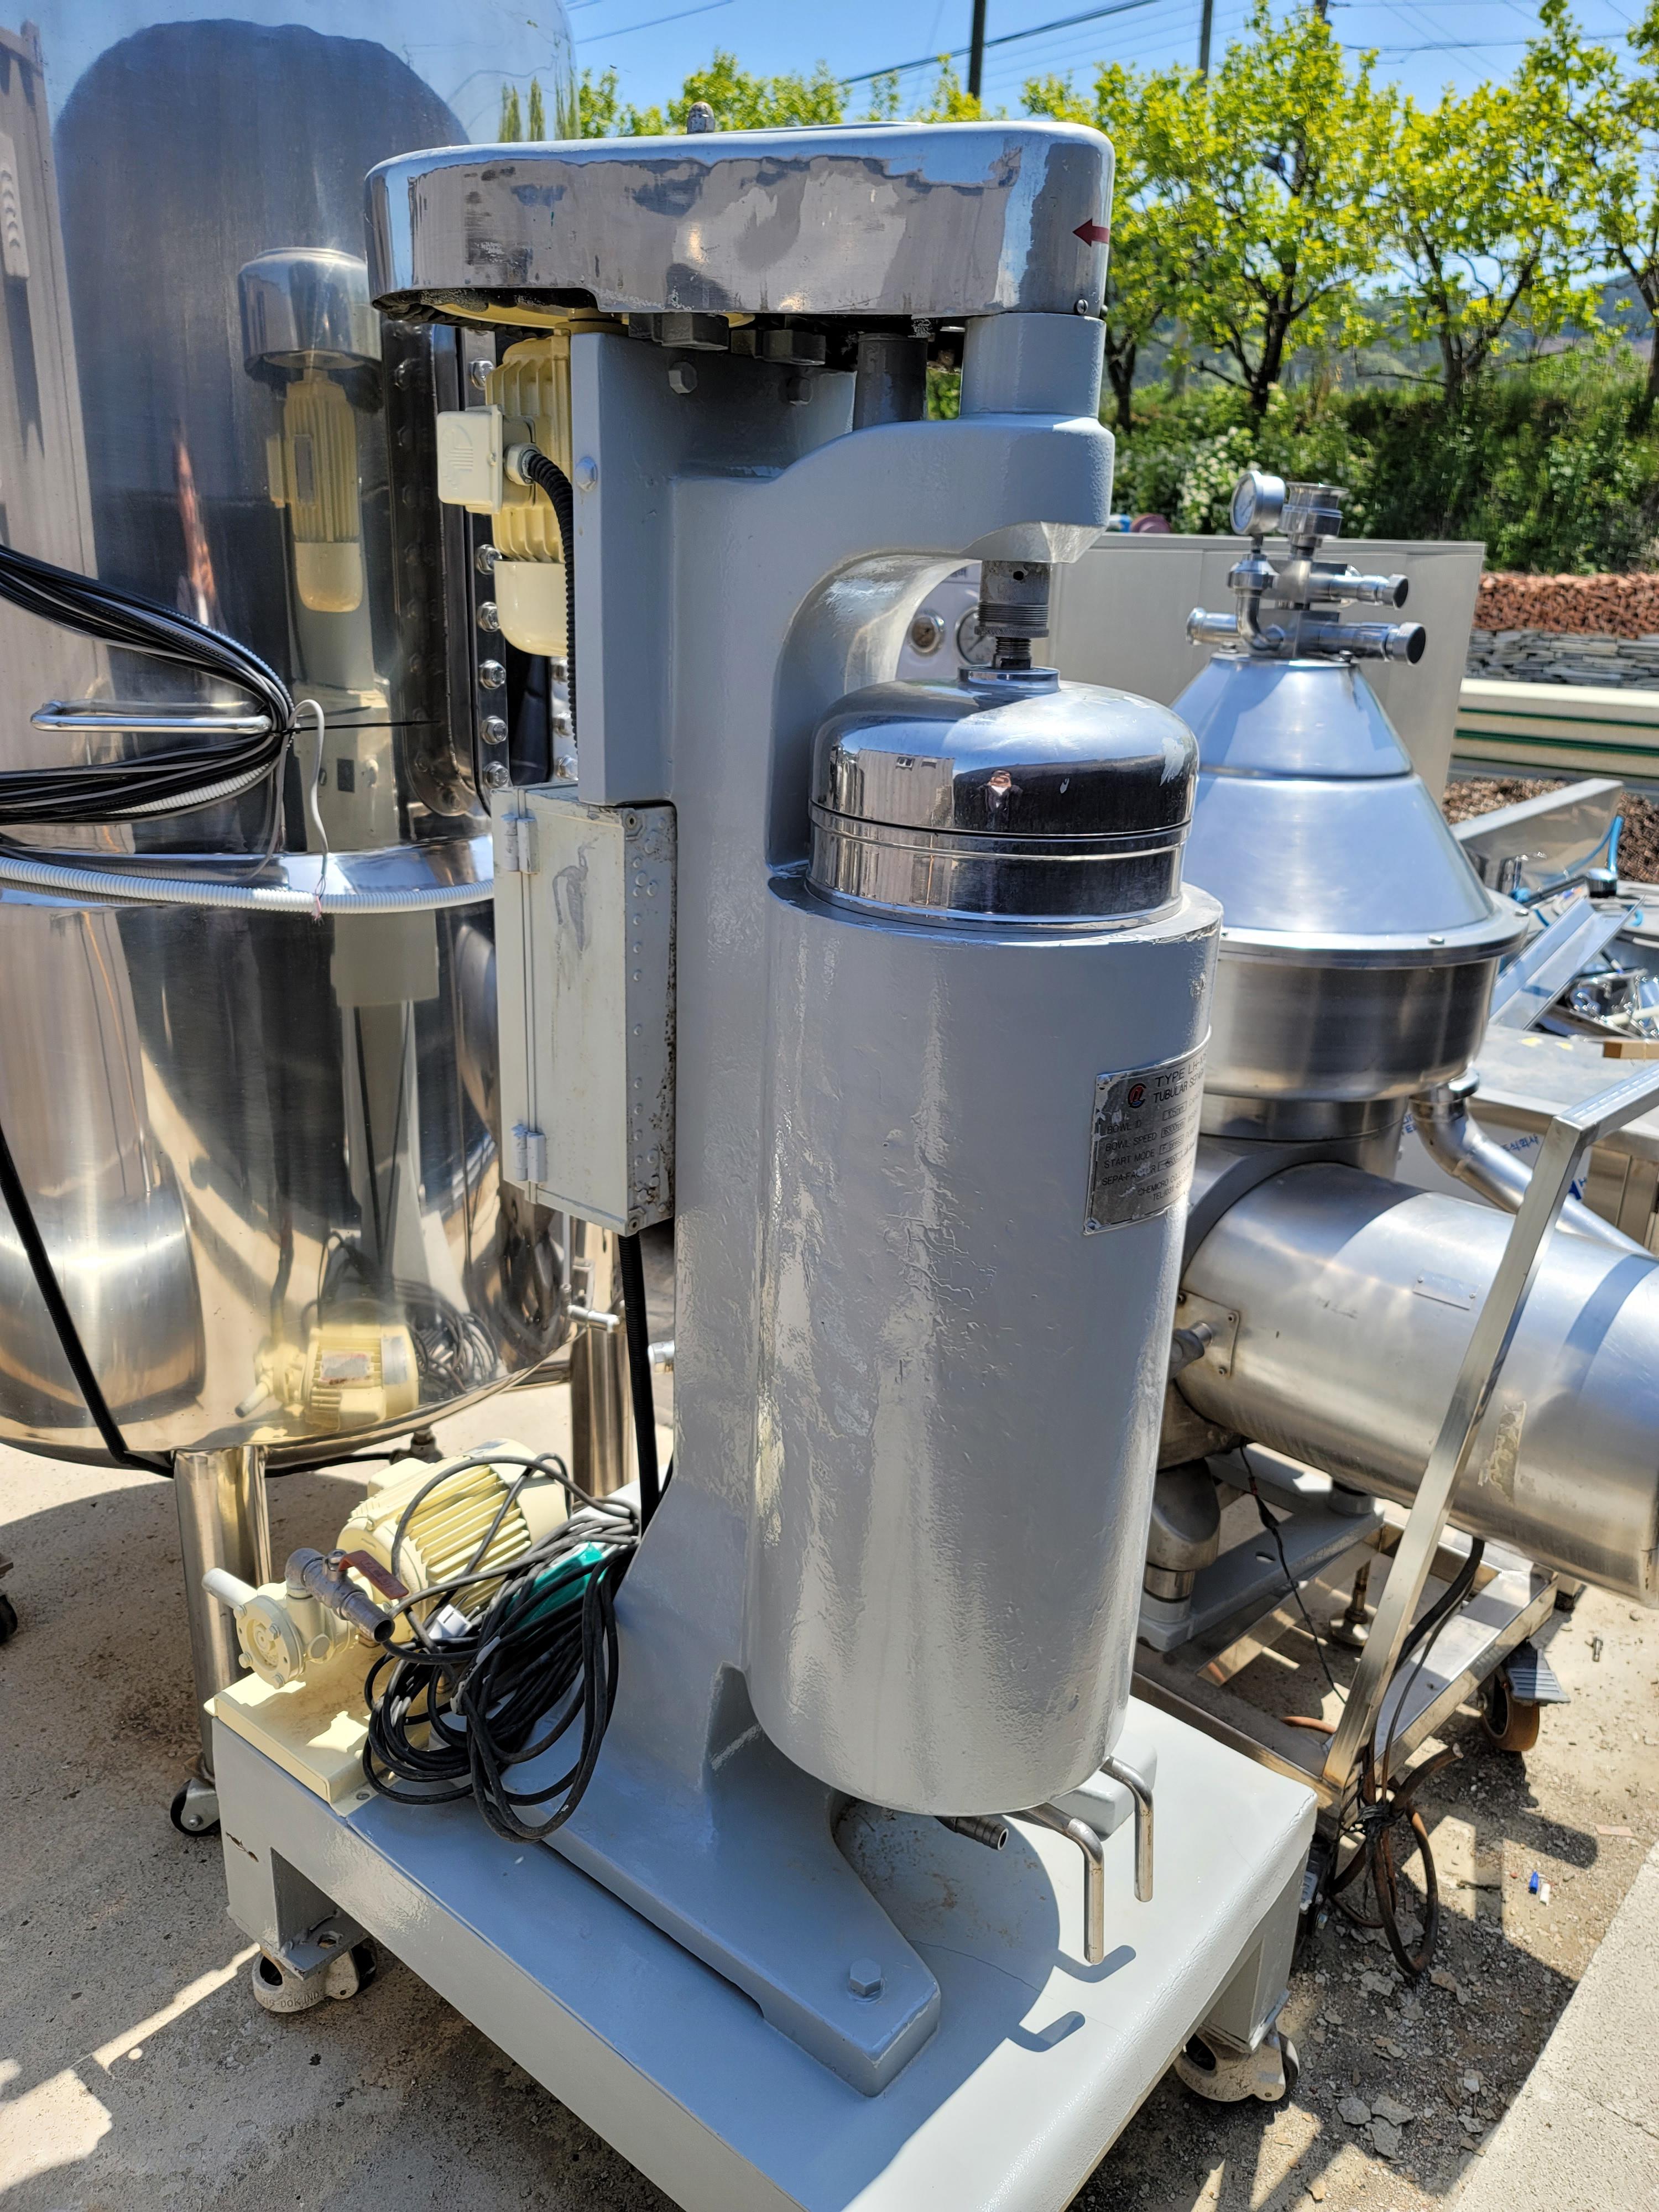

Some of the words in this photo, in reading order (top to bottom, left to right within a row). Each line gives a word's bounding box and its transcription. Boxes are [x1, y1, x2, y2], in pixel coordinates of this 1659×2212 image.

[1154, 1067, 1185, 1087] TYPE
[1153, 1081, 1188, 1103] TUBULAR
[1107, 1122, 1132, 1134] BOWL
[1105, 1139, 1130, 1151] BOWL
[1133, 1132, 1157, 1145] SPEED
[1104, 1155, 1131, 1168] START
[1134, 1149, 1155, 1161] MODE
[1138, 1178, 1169, 1196] CHEMICRO
